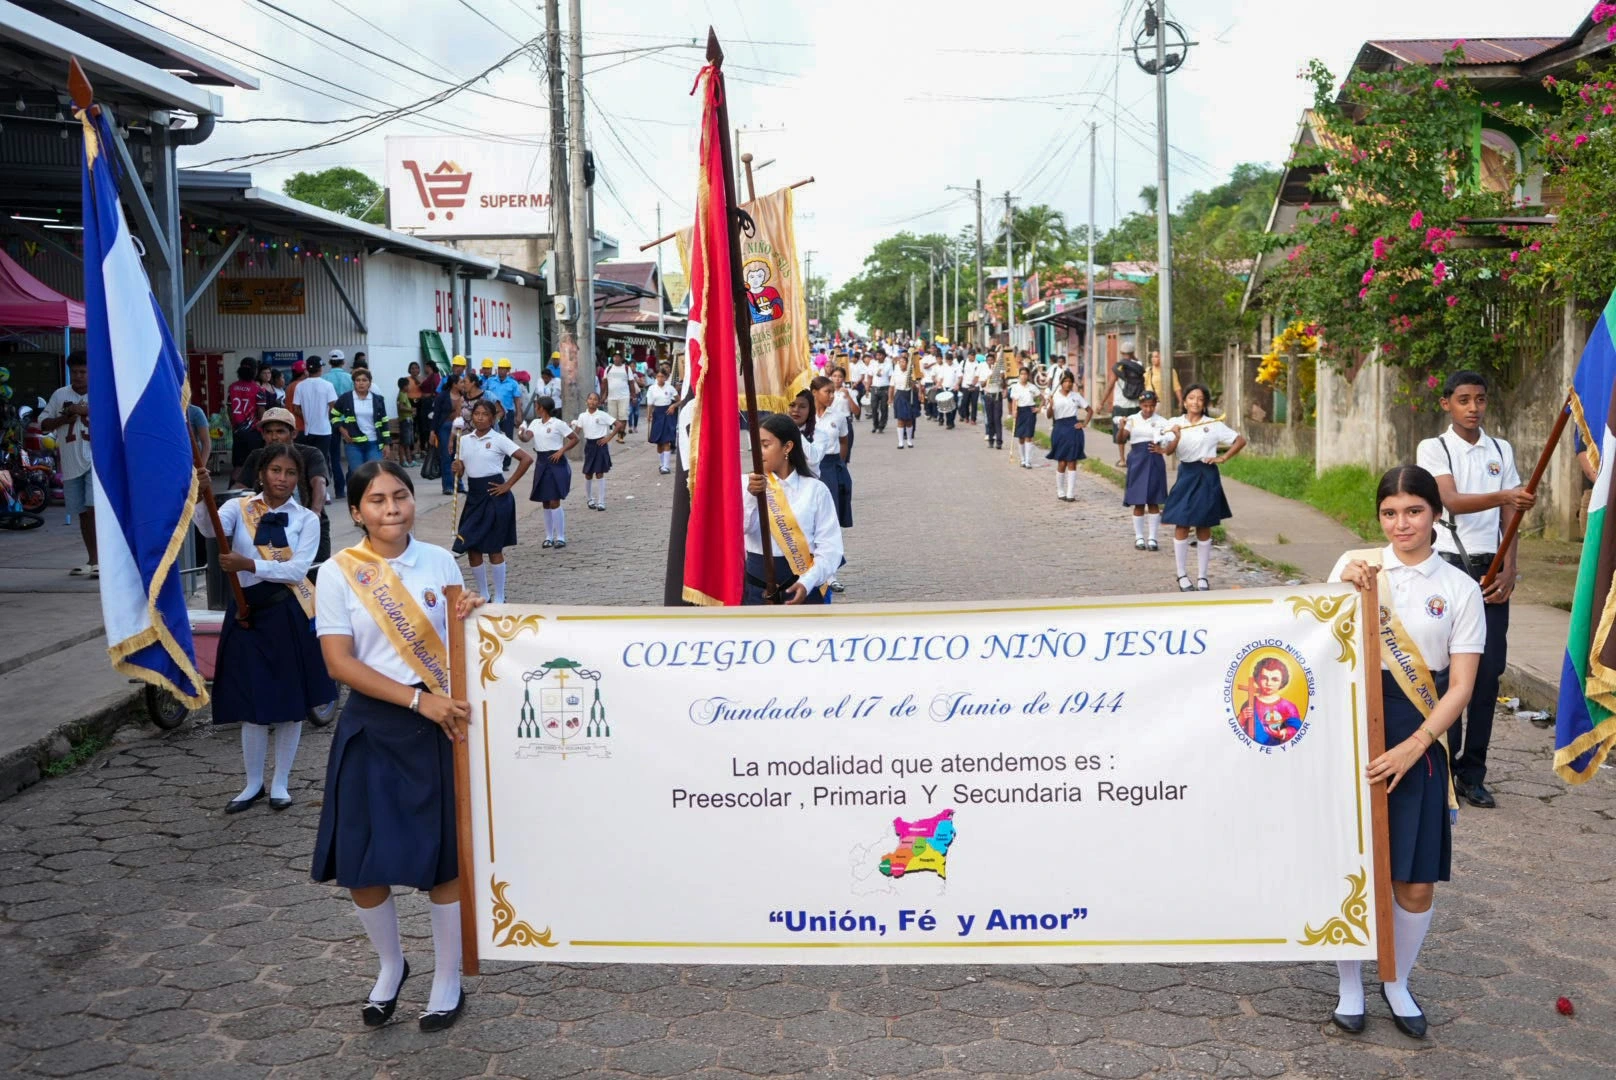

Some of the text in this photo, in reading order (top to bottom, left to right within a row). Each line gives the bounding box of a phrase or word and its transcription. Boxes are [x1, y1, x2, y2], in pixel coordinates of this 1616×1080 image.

[480, 193, 553, 208] SUPER MA
[233, 397, 250, 414] 27
[372, 584, 416, 642] Excelencia
[622, 628, 1209, 671] COLEGIO CATOLICO NIÑO JESUS
[1223, 661, 1239, 703] COLEGIO
[1236, 638, 1283, 660] CATOLICO
[1303, 666, 1316, 697] JESUS
[1380, 626, 1418, 684] Finalista
[1416, 684, 1435, 710] 2026
[689, 691, 1126, 726] Fundado el 17 de Junio de 1944
[1259, 745, 1272, 755] FE
[1280, 744, 1286, 752] Y
[1290, 721, 1311, 747] AMOR
[732, 757, 759, 777] La
[767, 754, 883, 776] modalidad
[891, 756, 932, 779] que
[941, 752, 1067, 773] atendemos
[672, 788, 792, 809] Preescolar
[813, 785, 907, 807] Primaria
[921, 784, 938, 804] Y
[953, 782, 1082, 804] Secundaria
[1098, 780, 1188, 806] Regular
[769, 908, 1088, 937] “Unión, Fé y Amor”
